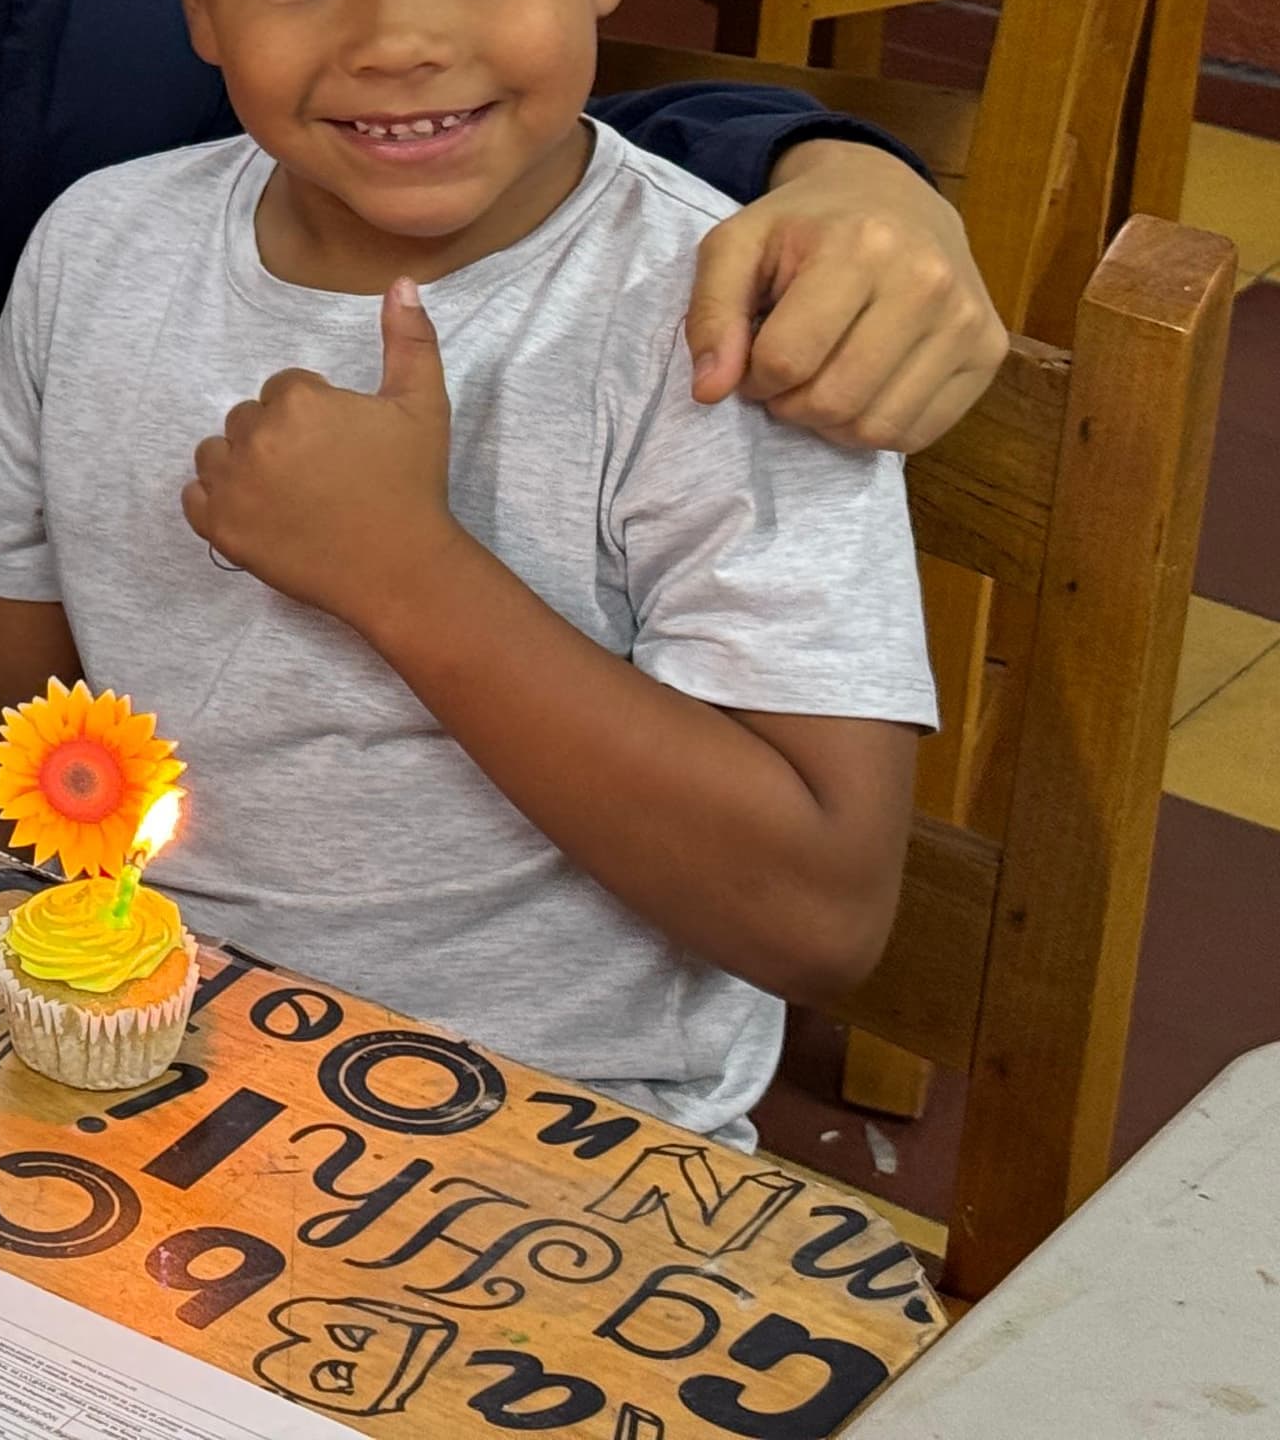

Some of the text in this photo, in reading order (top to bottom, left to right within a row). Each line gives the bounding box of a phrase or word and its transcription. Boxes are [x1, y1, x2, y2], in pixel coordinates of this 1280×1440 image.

[584, 1143, 806, 1258] N
[145, 1226, 286, 1330] b
[253, 1297, 459, 1414] B
[467, 1349, 606, 1430] a
[678, 1313, 889, 1440] G
